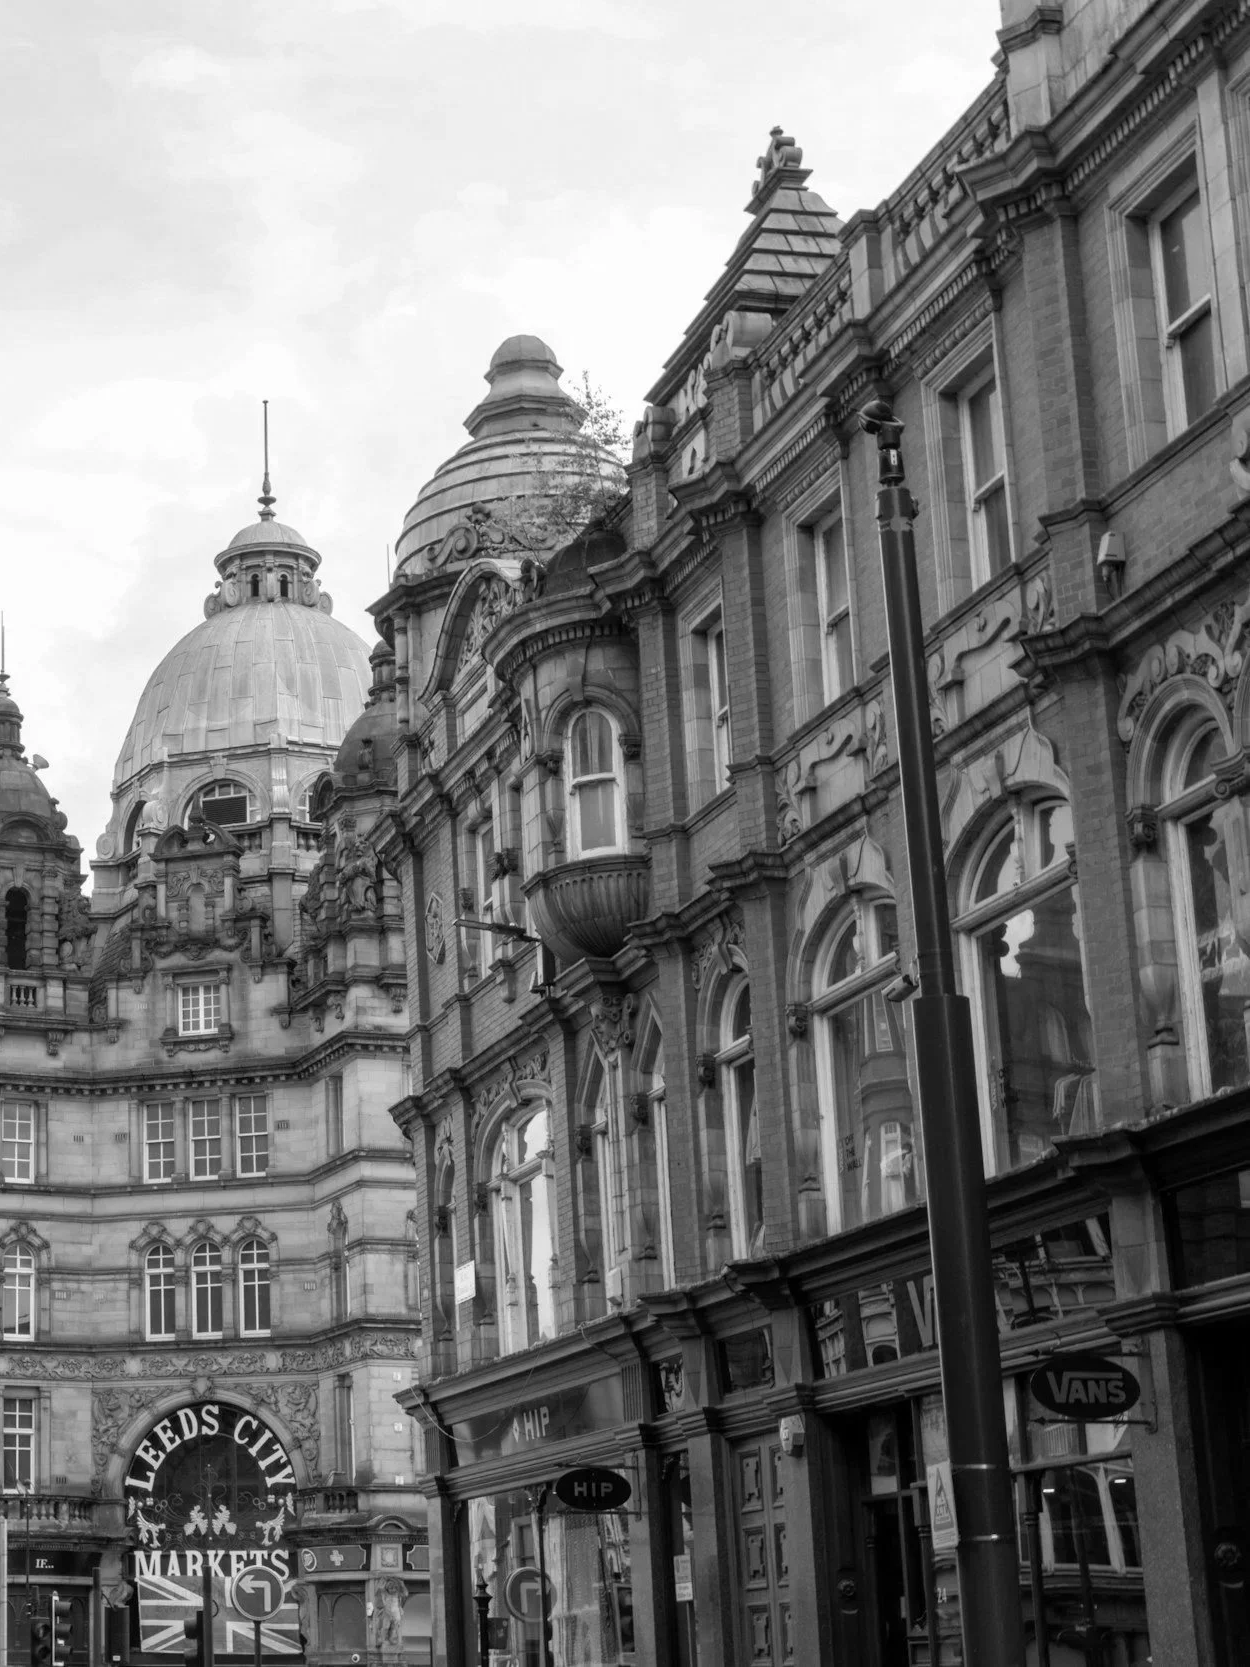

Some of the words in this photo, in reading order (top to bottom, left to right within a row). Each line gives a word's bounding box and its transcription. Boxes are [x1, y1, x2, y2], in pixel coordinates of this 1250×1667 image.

[1047, 1371, 1126, 1404] VANS
[523, 1405, 550, 1441] HIP
[125, 1404, 220, 1492] LEEDS
[233, 1415, 297, 1488] CITY
[573, 1481, 614, 1498] HIP
[134, 1549, 290, 1581] MARKETS
